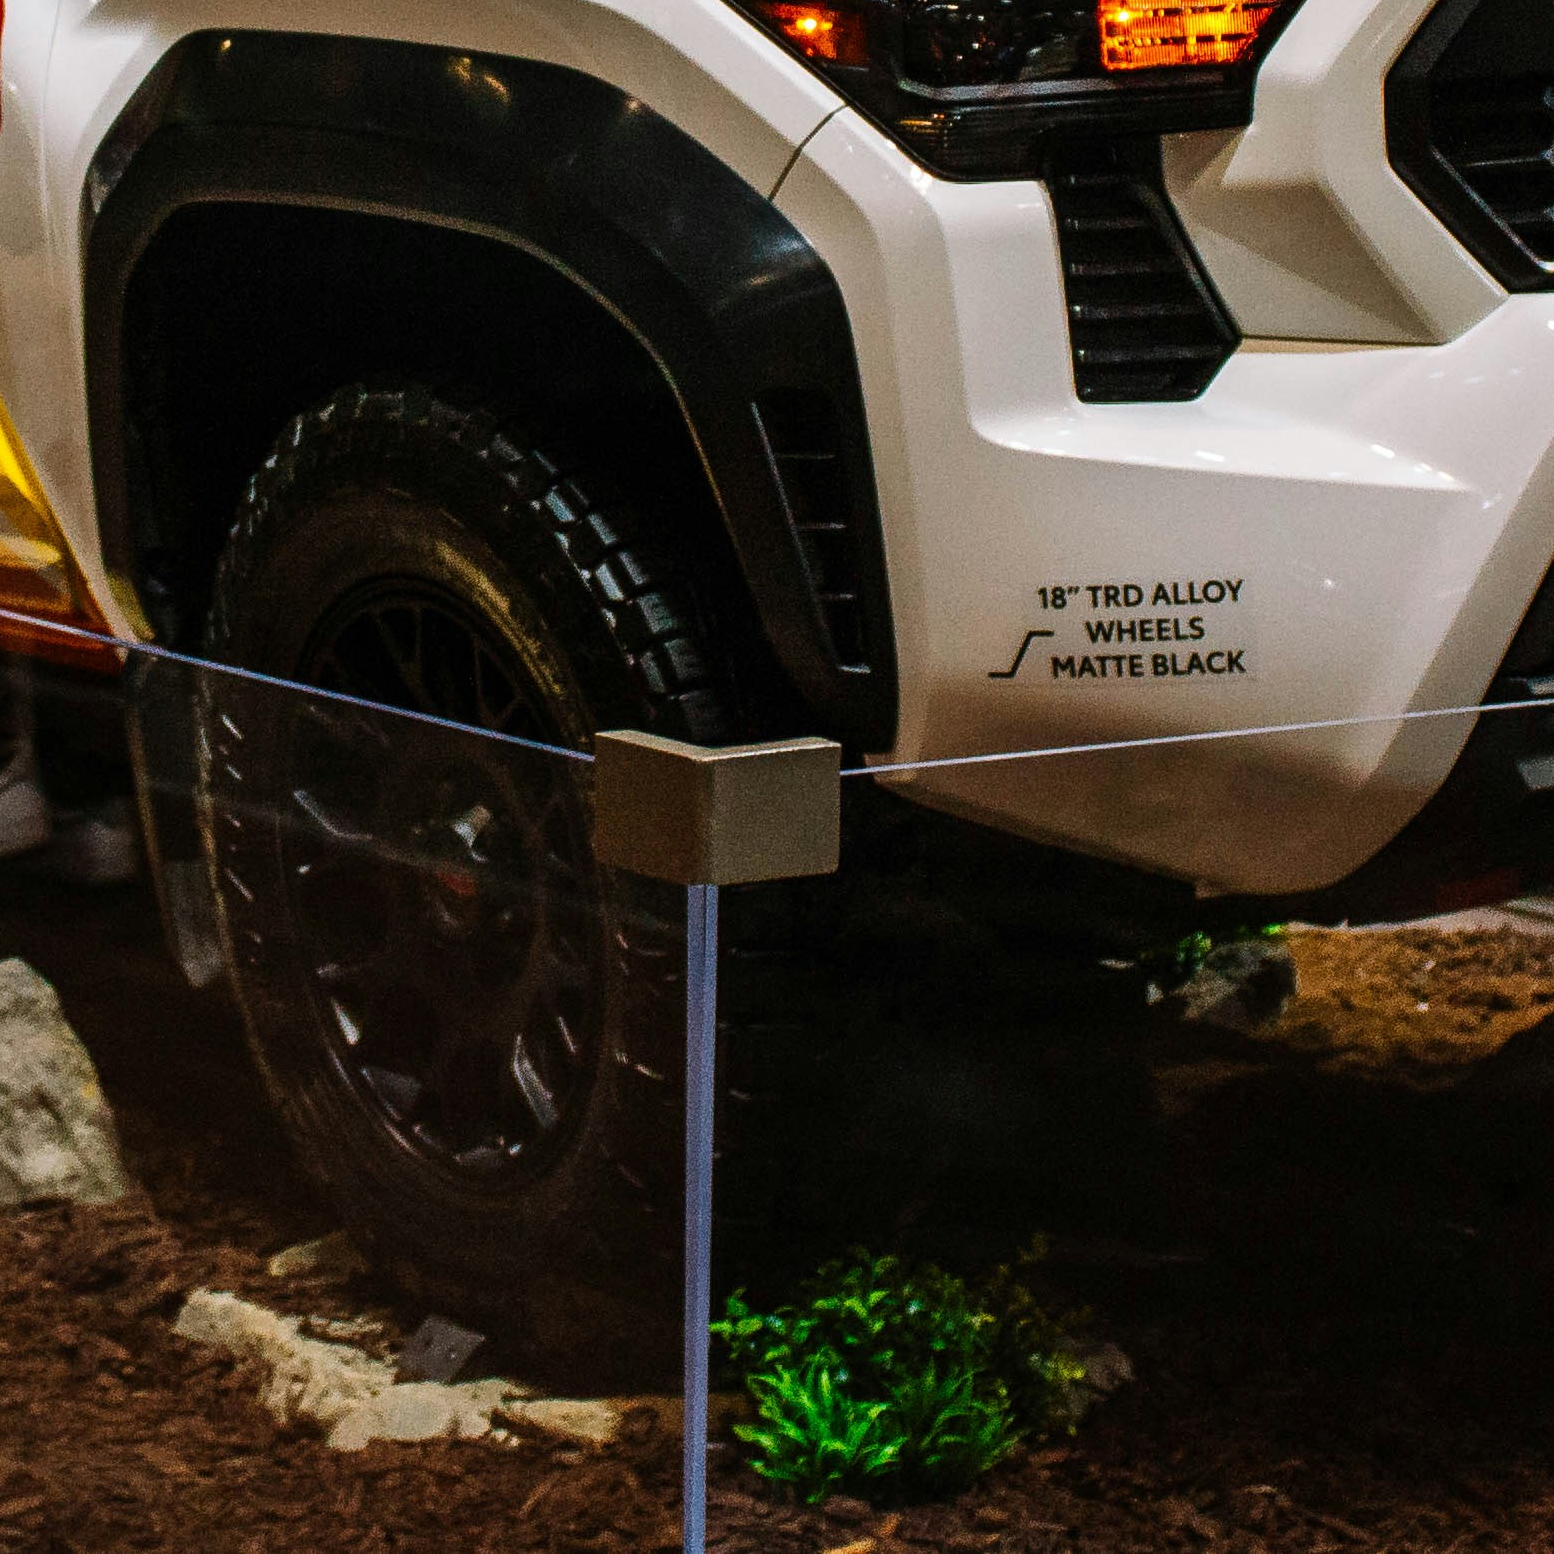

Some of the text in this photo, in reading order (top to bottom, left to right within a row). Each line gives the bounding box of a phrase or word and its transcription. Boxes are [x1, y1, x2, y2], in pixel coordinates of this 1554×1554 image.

[1086, 584, 1144, 608] TRD
[1151, 579, 1245, 606] ALLOY
[1085, 616, 1206, 644] WHEELS
[1051, 649, 1246, 679] MATTE BLACK
